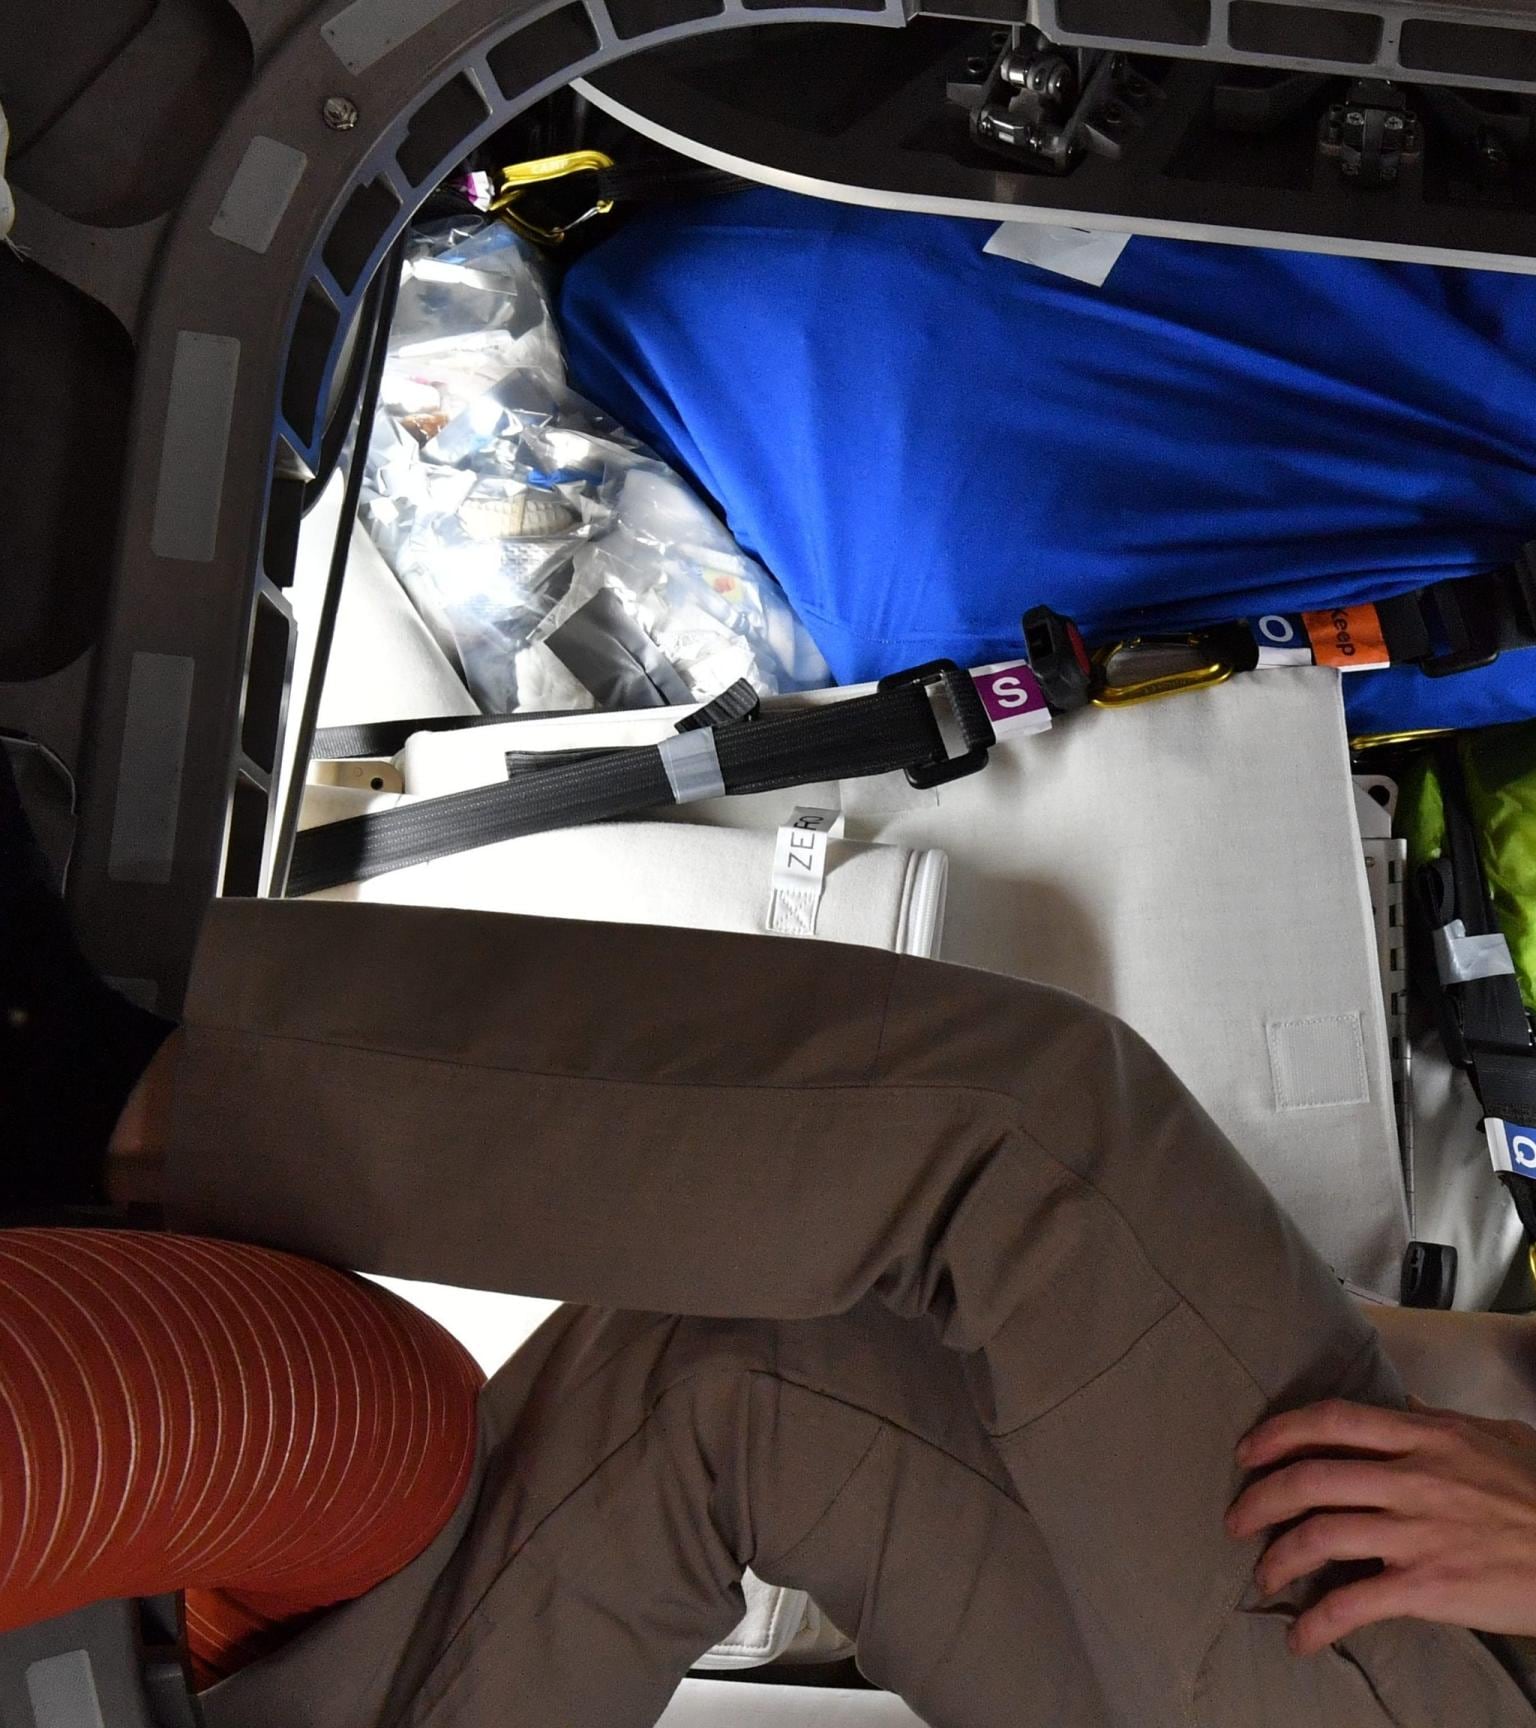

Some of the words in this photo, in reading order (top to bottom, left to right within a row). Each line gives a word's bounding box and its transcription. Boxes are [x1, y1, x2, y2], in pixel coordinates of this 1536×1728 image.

[1258, 614, 1294, 643] O
[991, 676, 1029, 710] S
[787, 815, 825, 872] ZERO
